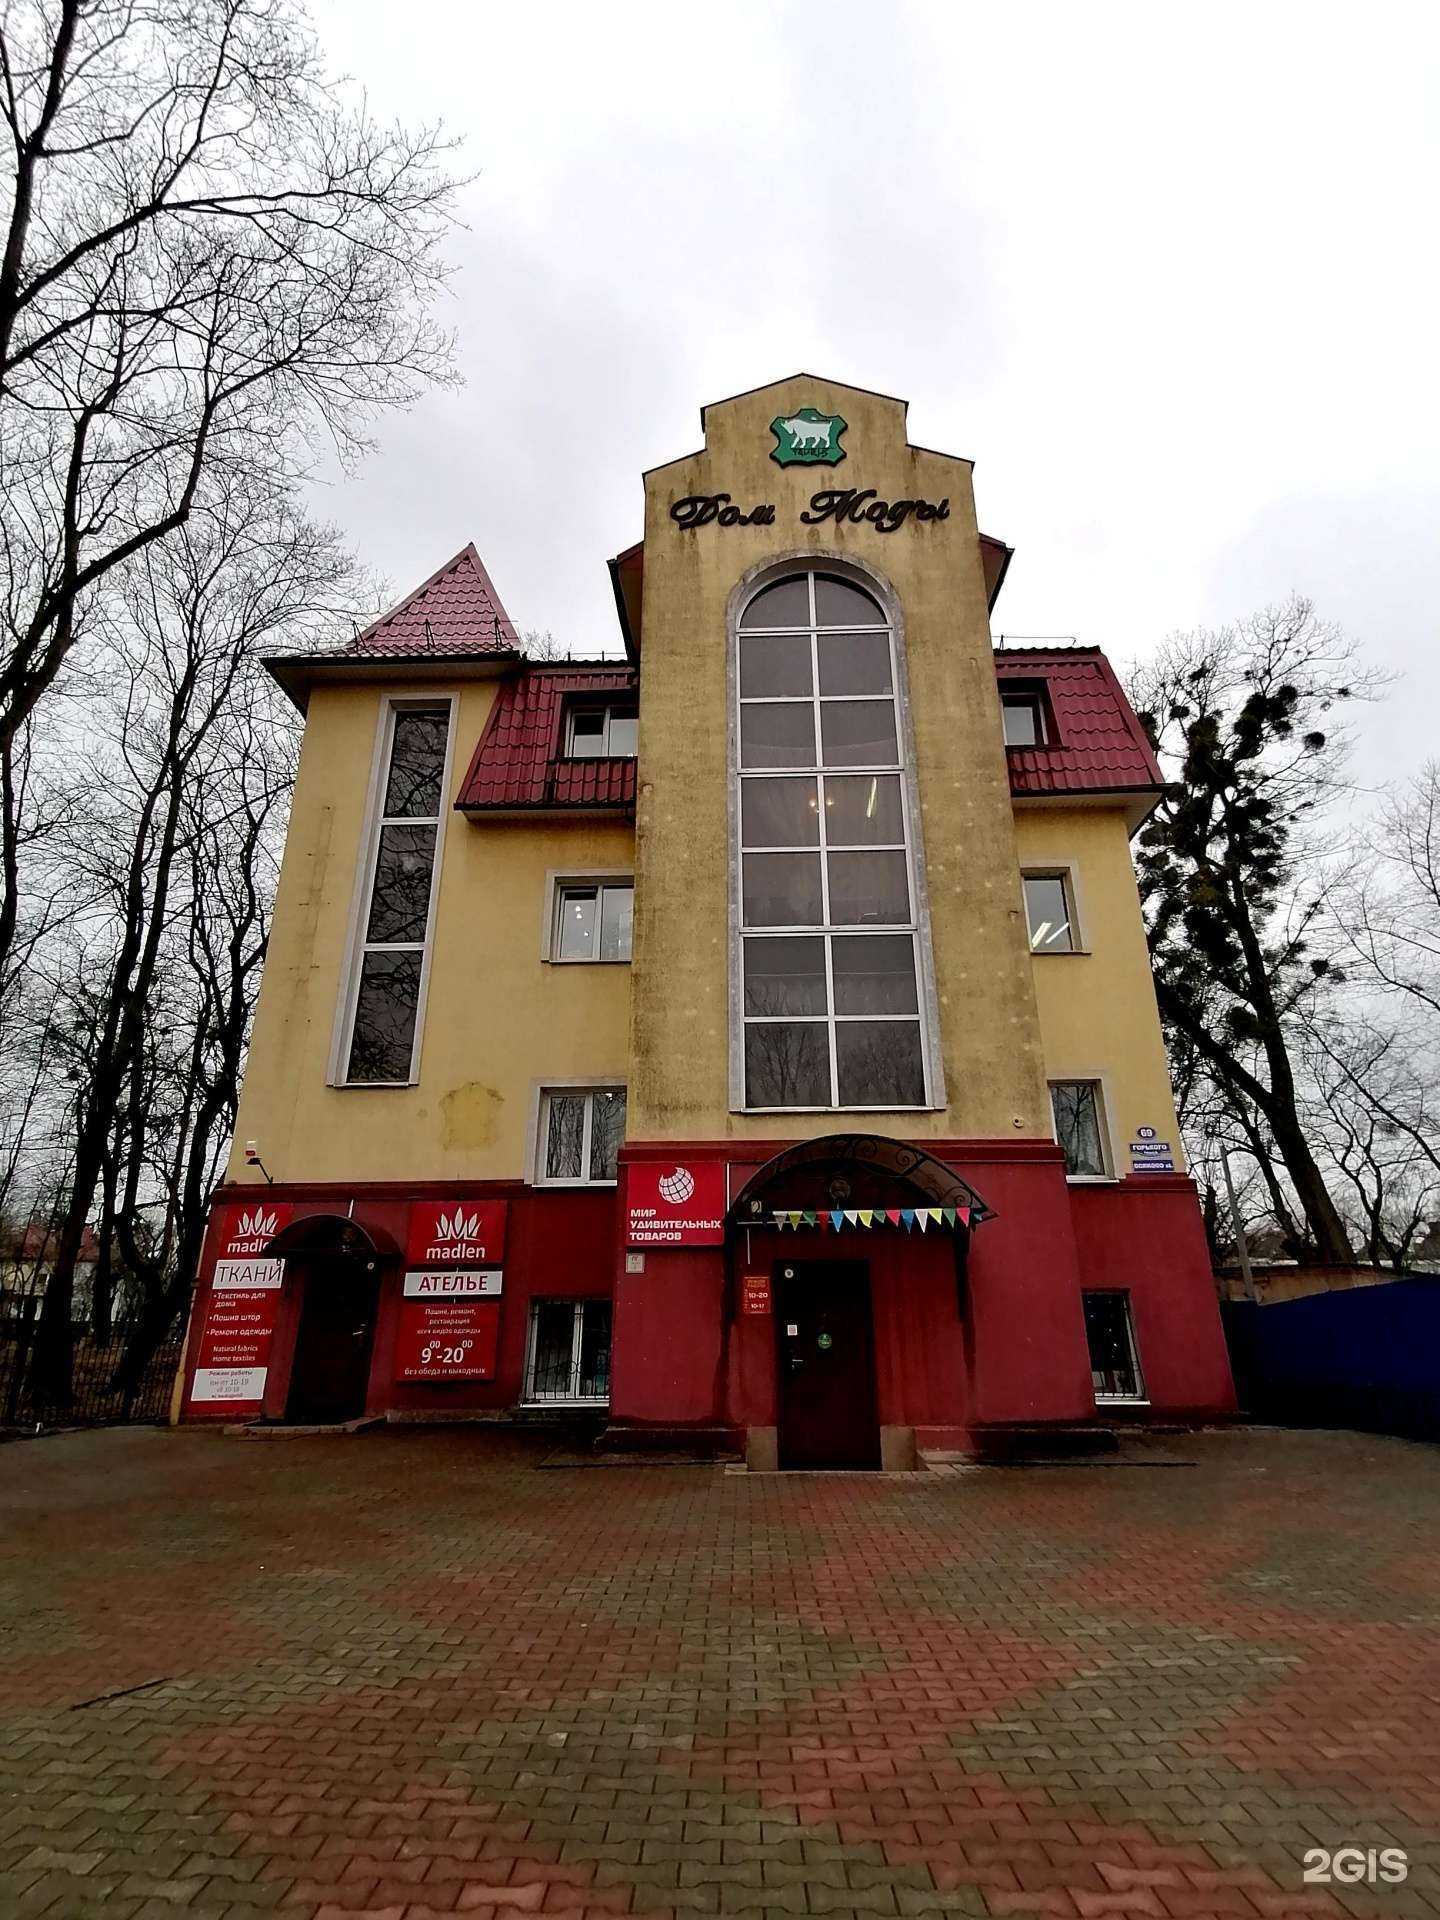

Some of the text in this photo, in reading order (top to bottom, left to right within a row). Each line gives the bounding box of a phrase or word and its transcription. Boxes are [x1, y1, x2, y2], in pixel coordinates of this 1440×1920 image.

[670, 488, 951, 533] Дом Моды
[1141, 1129, 1152, 1137] 69
[630, 1208, 657, 1218] МИР
[630, 1220, 722, 1229] УДИВИТЕЛЬНЫХ
[629, 1231, 682, 1241] ТОВАРОВ
[227, 1238, 270, 1253] madl
[426, 1243, 486, 1259] madlen
[418, 1275, 488, 1292] АТЕЛЬЕ
[217, 1292, 267, 1300] Текстиль для
[214, 1301, 237, 1309] дома
[240, 1313, 261, 1322] штор
[210, 1328, 273, 1337] Ремонт одежды
[213, 1345, 237, 1353] Natural
[404, 1367, 417, 1375] без
[418, 1367, 441, 1375] обеда
[448, 1367, 486, 1375] выходных
